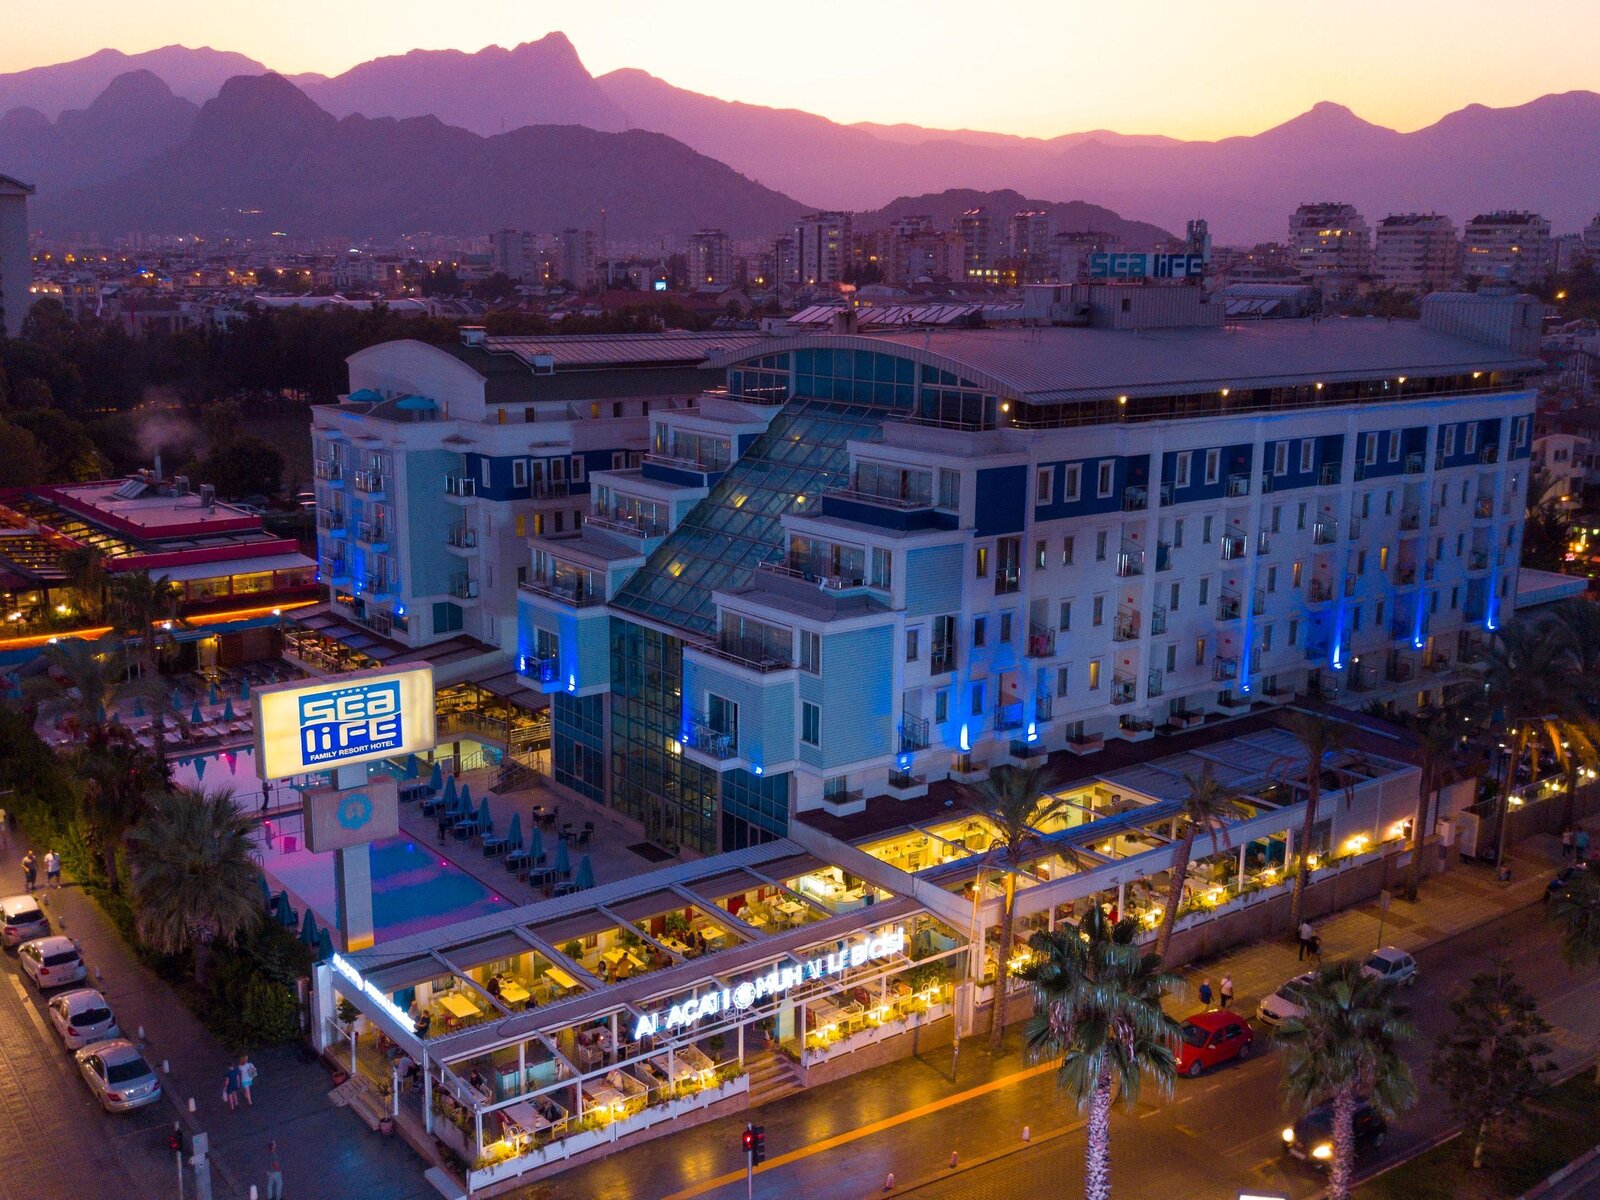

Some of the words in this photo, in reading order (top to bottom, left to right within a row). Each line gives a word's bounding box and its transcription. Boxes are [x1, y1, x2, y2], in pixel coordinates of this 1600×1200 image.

[310, 750, 337, 761] FAMILY
[338, 744, 369, 756] RESORT
[370, 740, 395, 750] HOTEL
